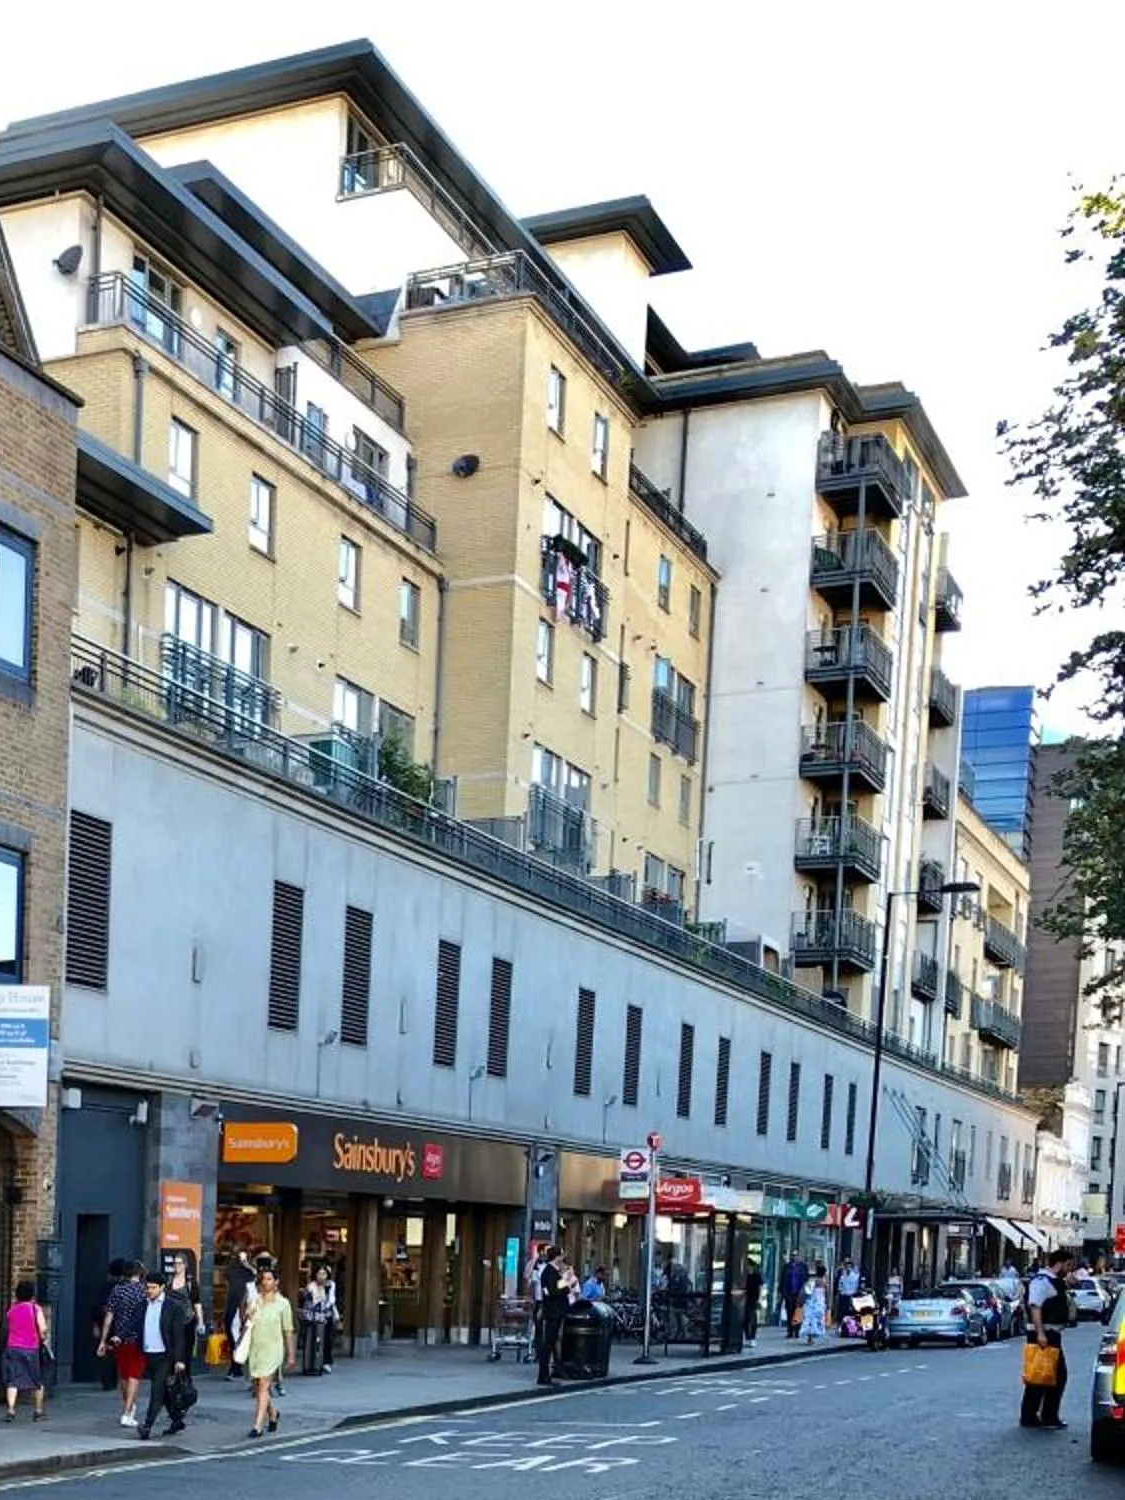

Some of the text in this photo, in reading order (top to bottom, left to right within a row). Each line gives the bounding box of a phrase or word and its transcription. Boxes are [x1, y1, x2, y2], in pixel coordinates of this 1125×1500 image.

[333, 1132, 416, 1183] Sainsbury's
[656, 1182, 695, 1196] Argos
[280, 1449, 641, 1474] CLEAR
